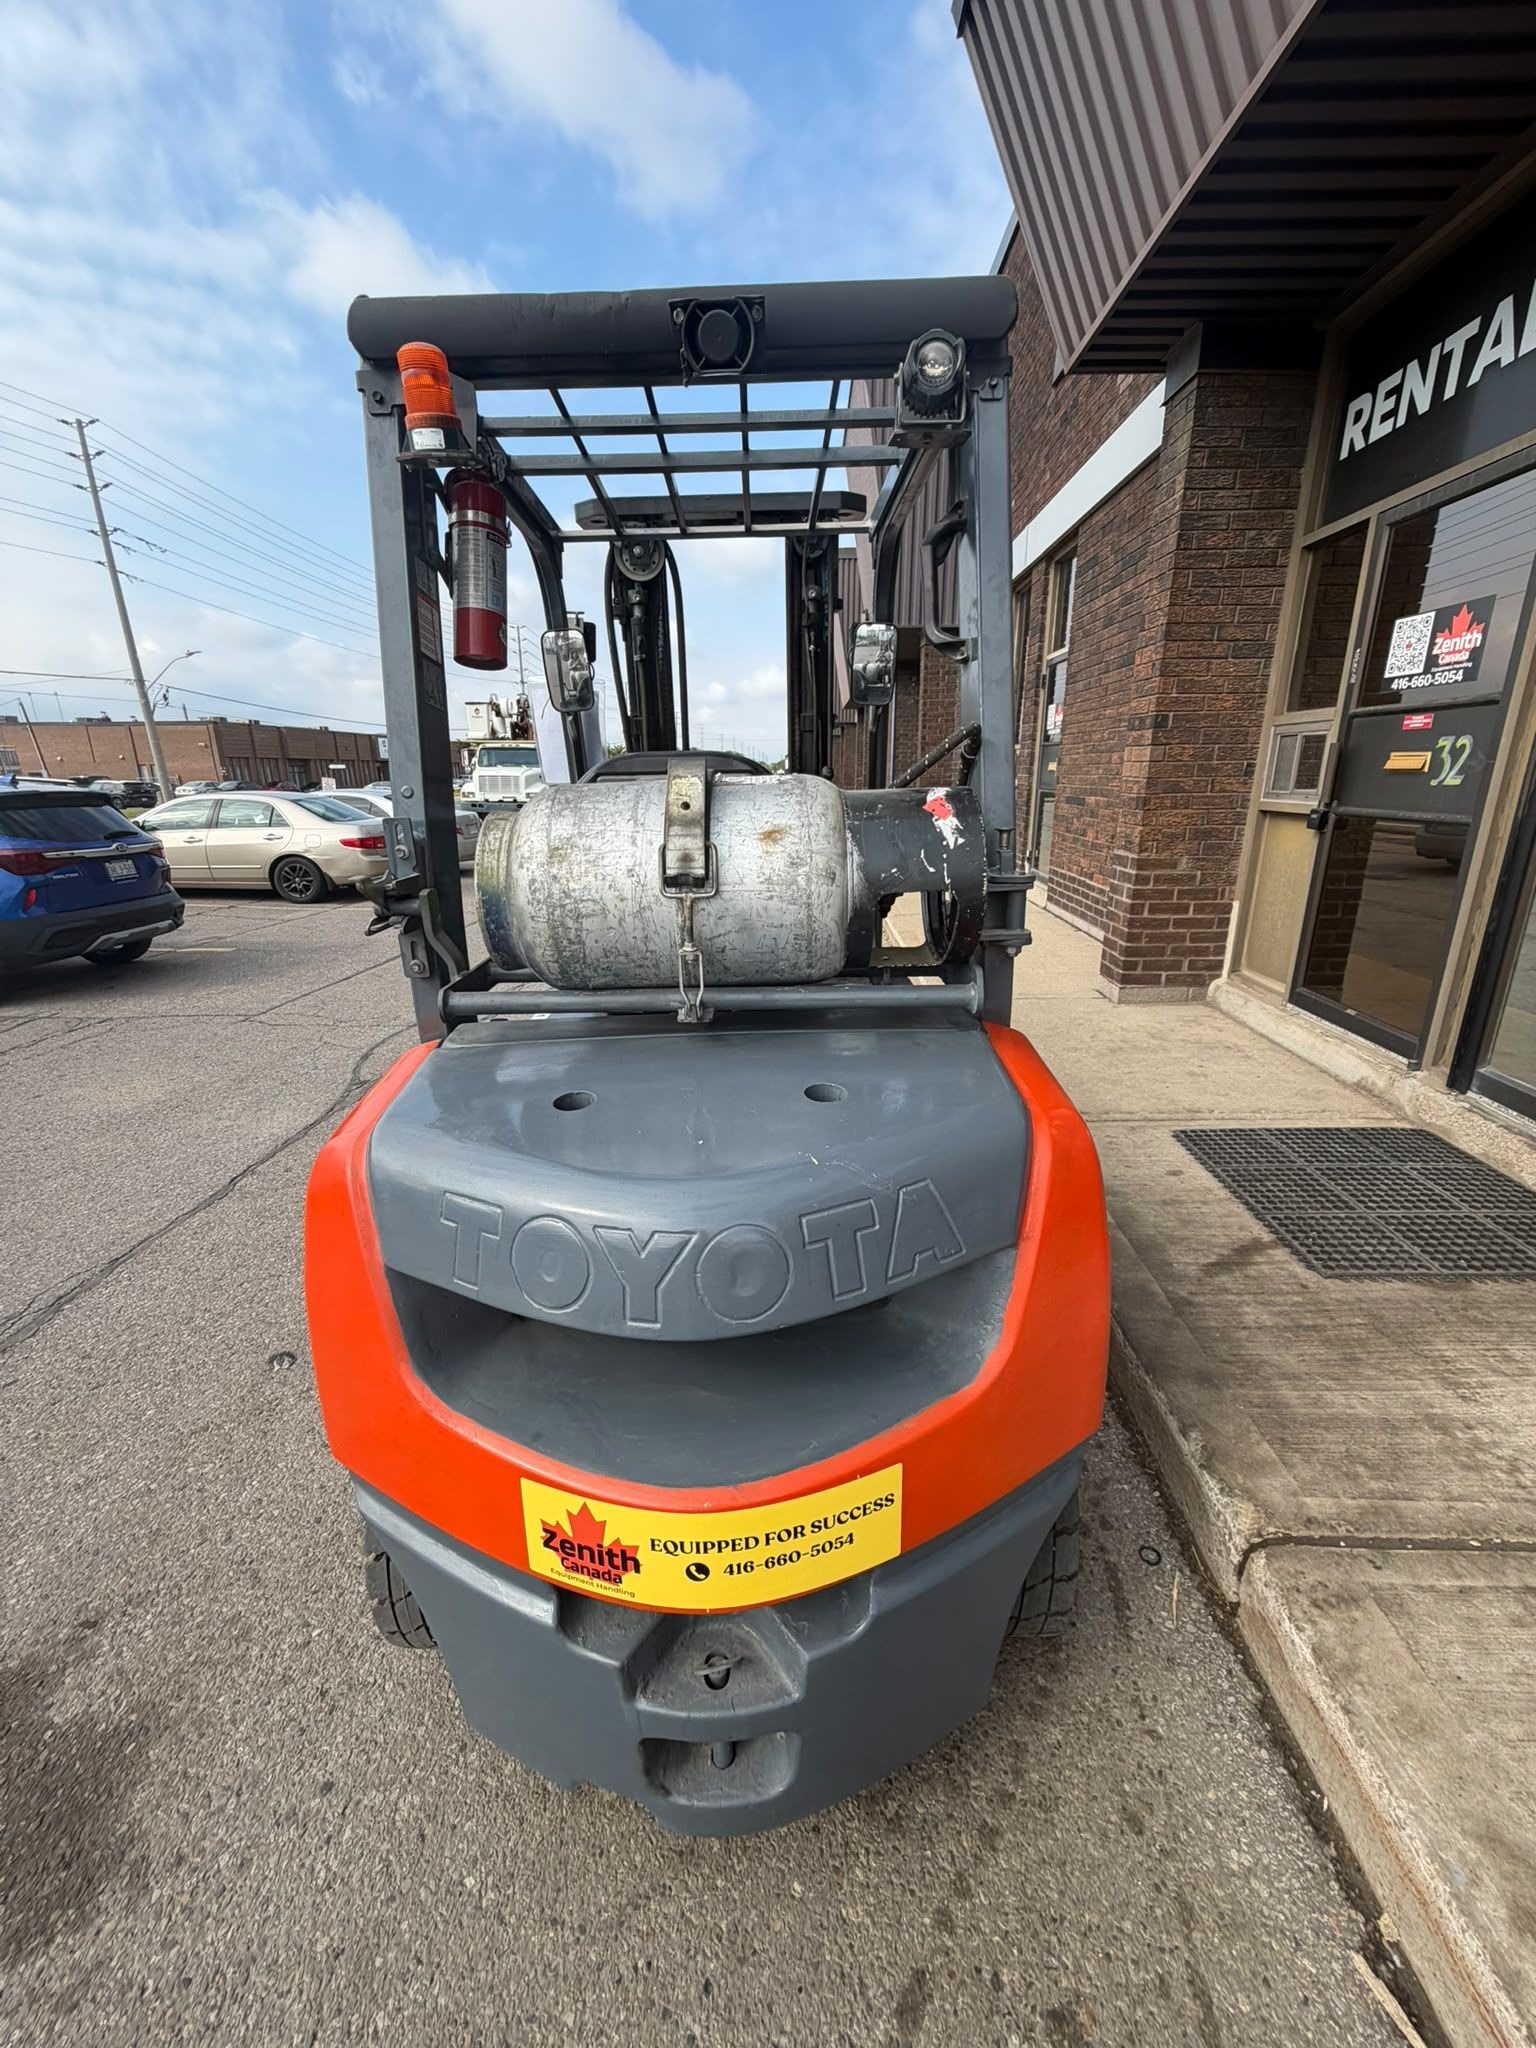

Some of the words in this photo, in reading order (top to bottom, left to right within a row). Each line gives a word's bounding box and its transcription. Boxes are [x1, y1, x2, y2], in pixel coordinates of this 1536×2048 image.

[1432, 629, 1483, 655] Zenith
[1438, 651, 1470, 665] Canada
[1391, 669, 1464, 690] 416-660-5054
[1430, 734, 1474, 787] 32
[440, 1178, 966, 1329] TOYOTA
[649, 1536, 760, 1556] EQUIPPED
[764, 1525, 806, 1546] FOR
[810, 1493, 896, 1534] SUCCESS
[542, 1527, 641, 1574] Zenith
[723, 1532, 855, 1576] 416-660-5054
[550, 1567, 595, 1588] Equipment
[596, 1582, 636, 1598] Handling
[561, 1556, 623, 1585] Canada
